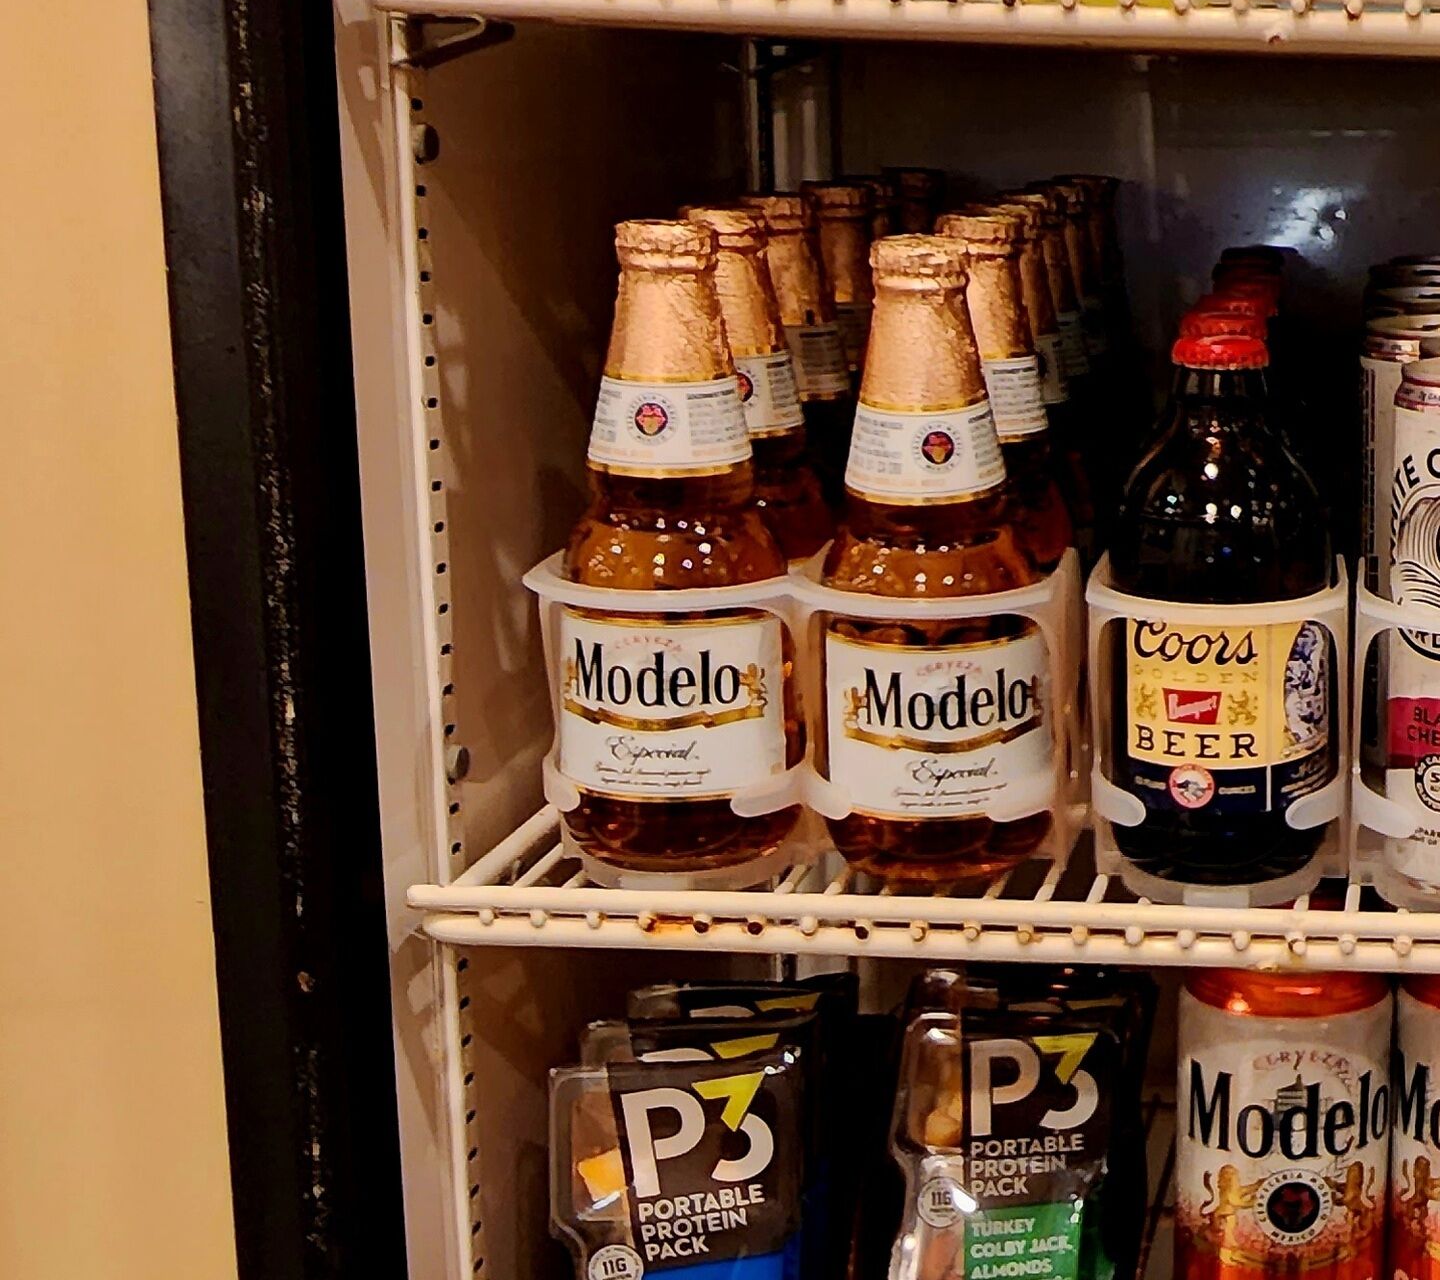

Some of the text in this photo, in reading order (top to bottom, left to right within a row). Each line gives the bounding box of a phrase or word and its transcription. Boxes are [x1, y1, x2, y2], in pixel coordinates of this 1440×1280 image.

[1132, 616, 1259, 666] Coors
[573, 636, 742, 708] Modelo
[1134, 664, 1258, 684] GOLDEN
[862, 666, 1030, 732] Modelo
[1135, 723, 1259, 759] BEER
[969, 1031, 1099, 1137] P3
[1187, 1058, 1389, 1160] Modelo
[620, 1070, 774, 1198] P3
[971, 1133, 1085, 1158] PORTABLE
[970, 1153, 1067, 1178] PROTEIN
[637, 1183, 766, 1222] PORTABLE
[971, 1176, 1029, 1198] PACK
[640, 1207, 748, 1242] PROTEIN
[970, 1217, 1035, 1237] TURKEY
[644, 1234, 710, 1262] PACK
[970, 1235, 1073, 1259] COLBY JACK
[602, 1256, 628, 1275] 11G
[971, 1258, 1053, 1280] ALMONDS
